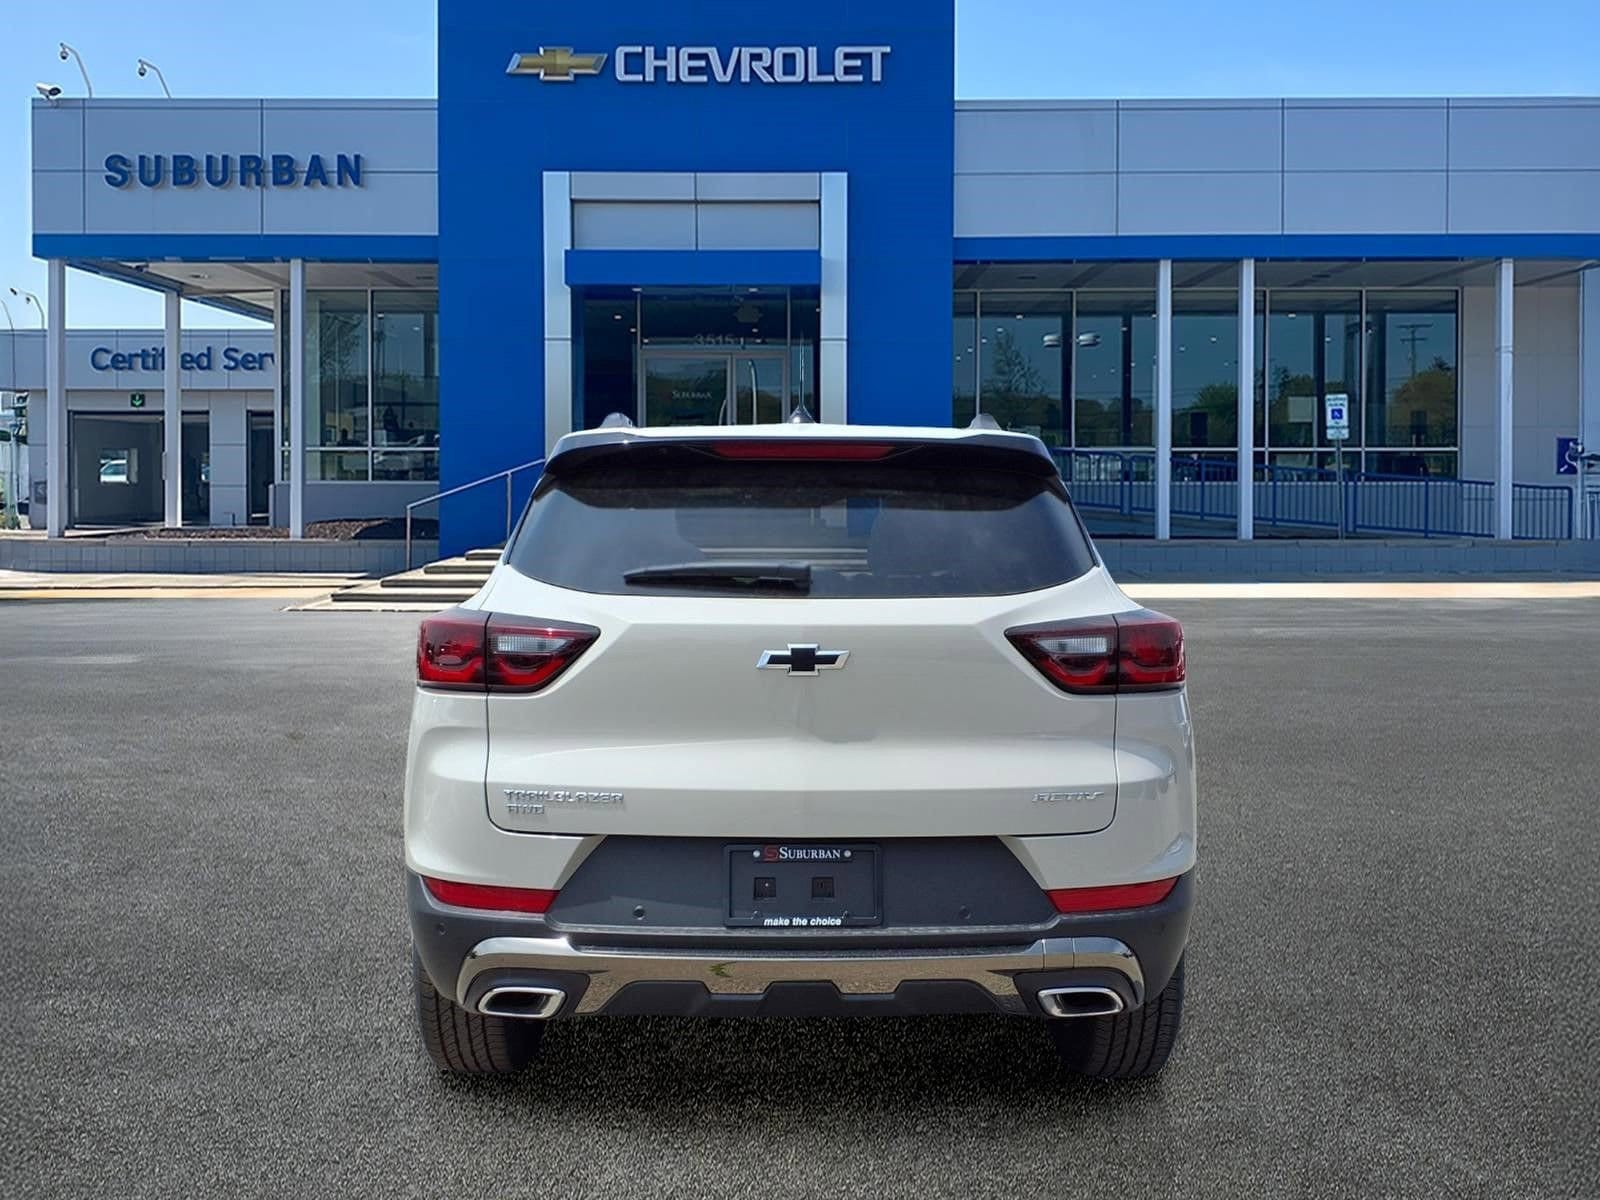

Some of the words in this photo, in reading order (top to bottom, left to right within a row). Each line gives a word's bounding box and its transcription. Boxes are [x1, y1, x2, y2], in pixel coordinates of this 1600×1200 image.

[615, 45, 892, 84] CHEVROLET
[104, 153, 364, 189] SUBURBAN
[90, 347, 213, 372] Certifed
[503, 788, 625, 804] TRAILBLAZER
[1032, 791, 1104, 803] ACTIV
[506, 803, 546, 815] AWD
[779, 846, 841, 860] SUBURBAN
[763, 917, 790, 926] make
[791, 916, 808, 926] the
[809, 916, 842, 926] choice
